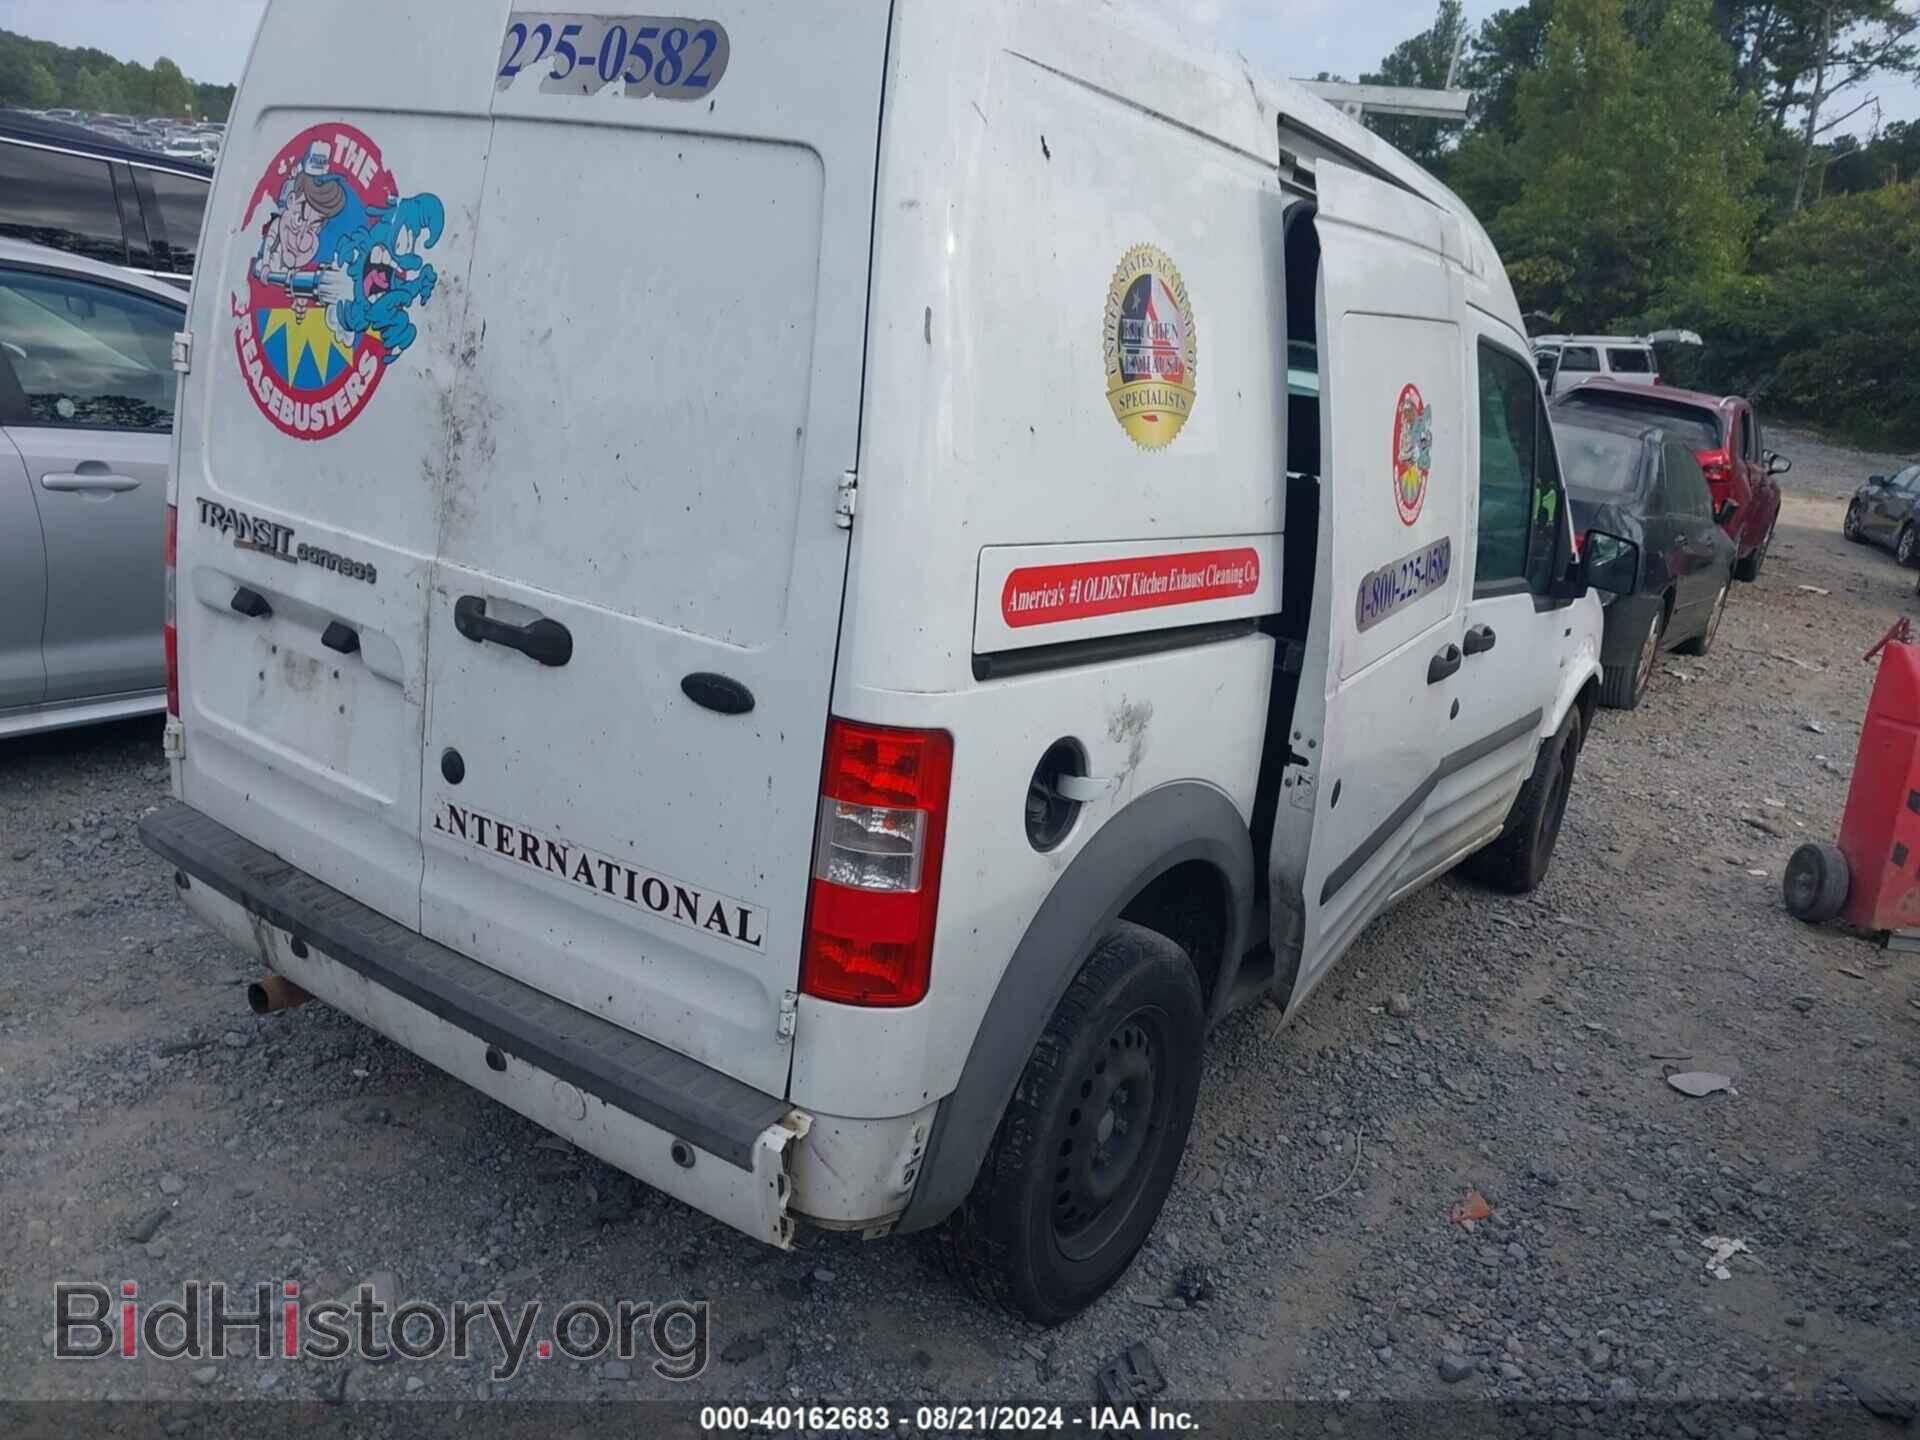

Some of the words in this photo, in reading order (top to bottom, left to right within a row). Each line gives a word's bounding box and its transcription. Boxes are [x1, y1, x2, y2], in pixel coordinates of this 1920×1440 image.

[498, 23, 718, 88] 225-0582
[333, 133, 379, 190] THE
[1119, 389, 1187, 412] SPECIALISTS
[196, 497, 296, 556] TRANSIT
[297, 543, 377, 584] connect
[1008, 581, 1066, 612] America's
[1069, 578, 1083, 604] #1
[1084, 573, 1131, 603] OLDEST
[1131, 571, 1169, 597] Kitchen
[1169, 568, 1206, 592] Exhaust
[1206, 563, 1244, 589] Cleaning
[1244, 560, 1257, 582] Co.
